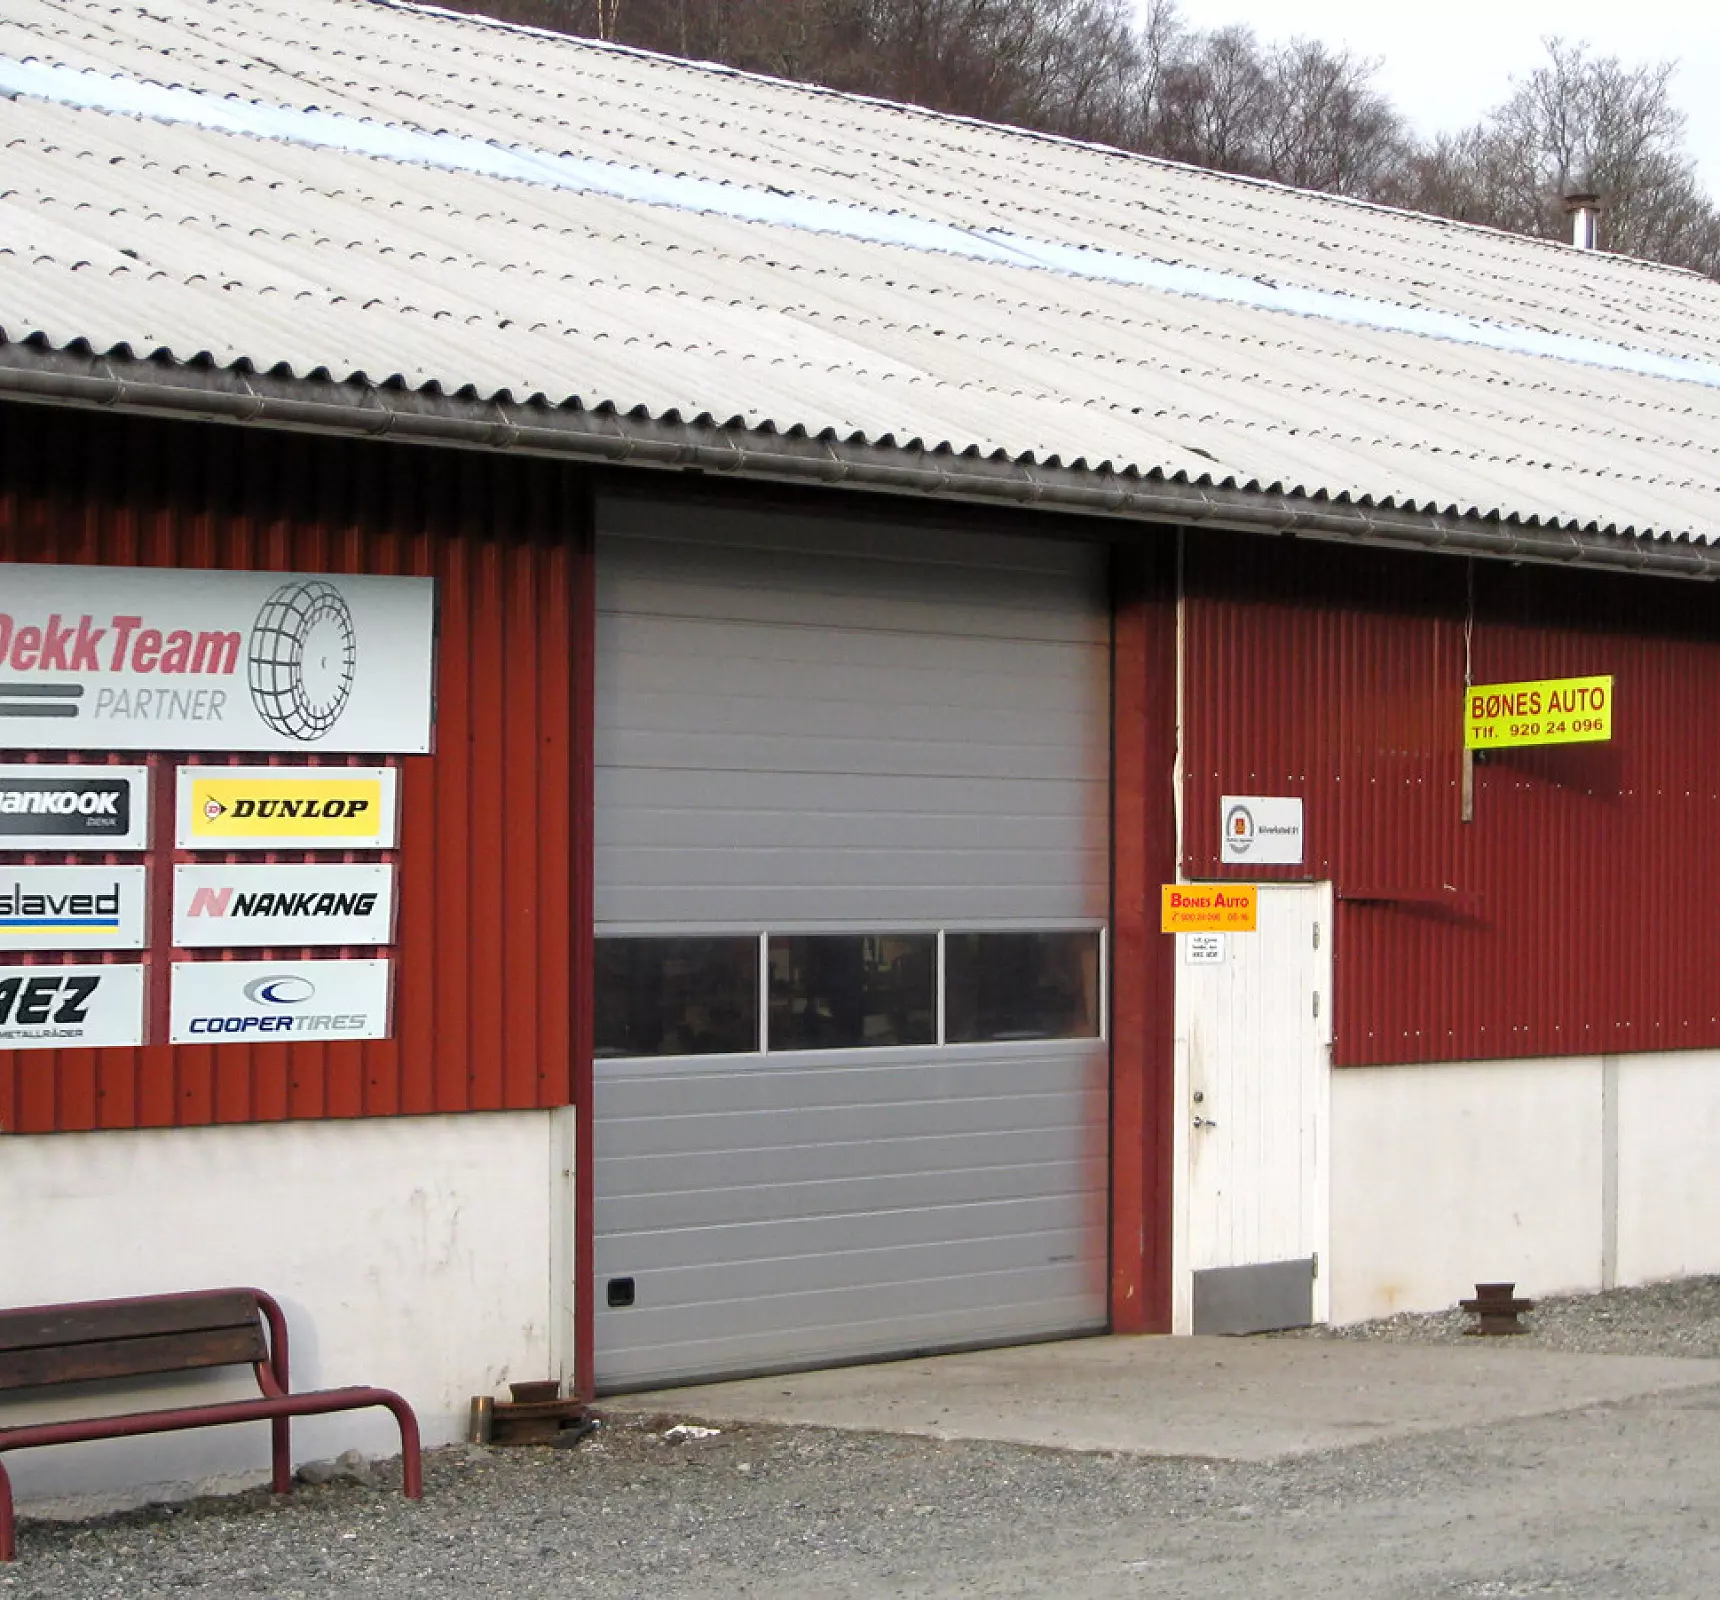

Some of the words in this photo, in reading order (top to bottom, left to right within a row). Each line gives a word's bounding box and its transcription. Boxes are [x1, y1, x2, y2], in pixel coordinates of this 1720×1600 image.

[94, 688, 227, 721] PARTNER
[1472, 691, 1541, 719] BØNES
[1548, 687, 1605, 713] AUTO
[1510, 723, 1541, 736] 920
[1546, 720, 1566, 734] 24
[1572, 718, 1604, 733] 096
[230, 799, 369, 818] DUNLOP
[231, 892, 378, 917] NANKANG
[1214, 892, 1249, 909] AUTO
